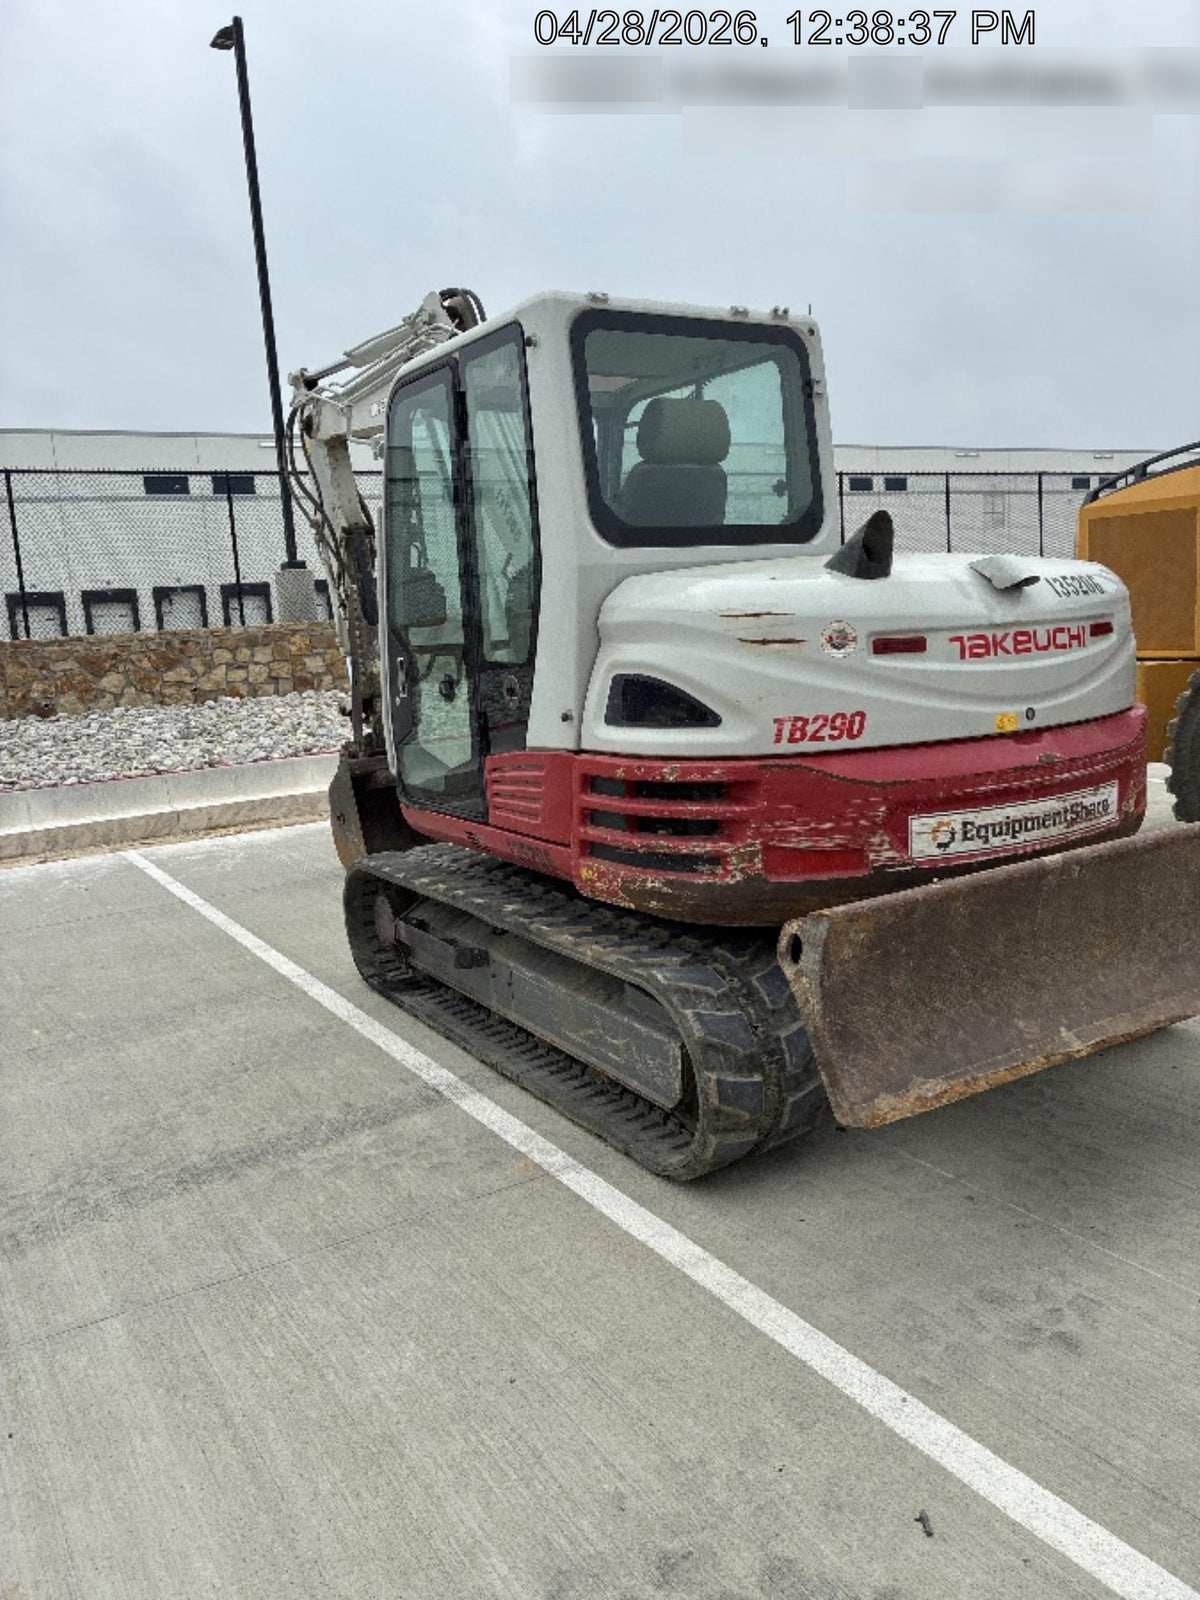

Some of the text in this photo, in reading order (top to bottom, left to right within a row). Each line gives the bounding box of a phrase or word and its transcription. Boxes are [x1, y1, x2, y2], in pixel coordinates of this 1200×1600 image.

[1043, 574, 1105, 598] 135206
[948, 625, 1086, 660] TAKEUCHI
[773, 710, 867, 745] TB290
[961, 796, 1110, 845] EquipmentShare
